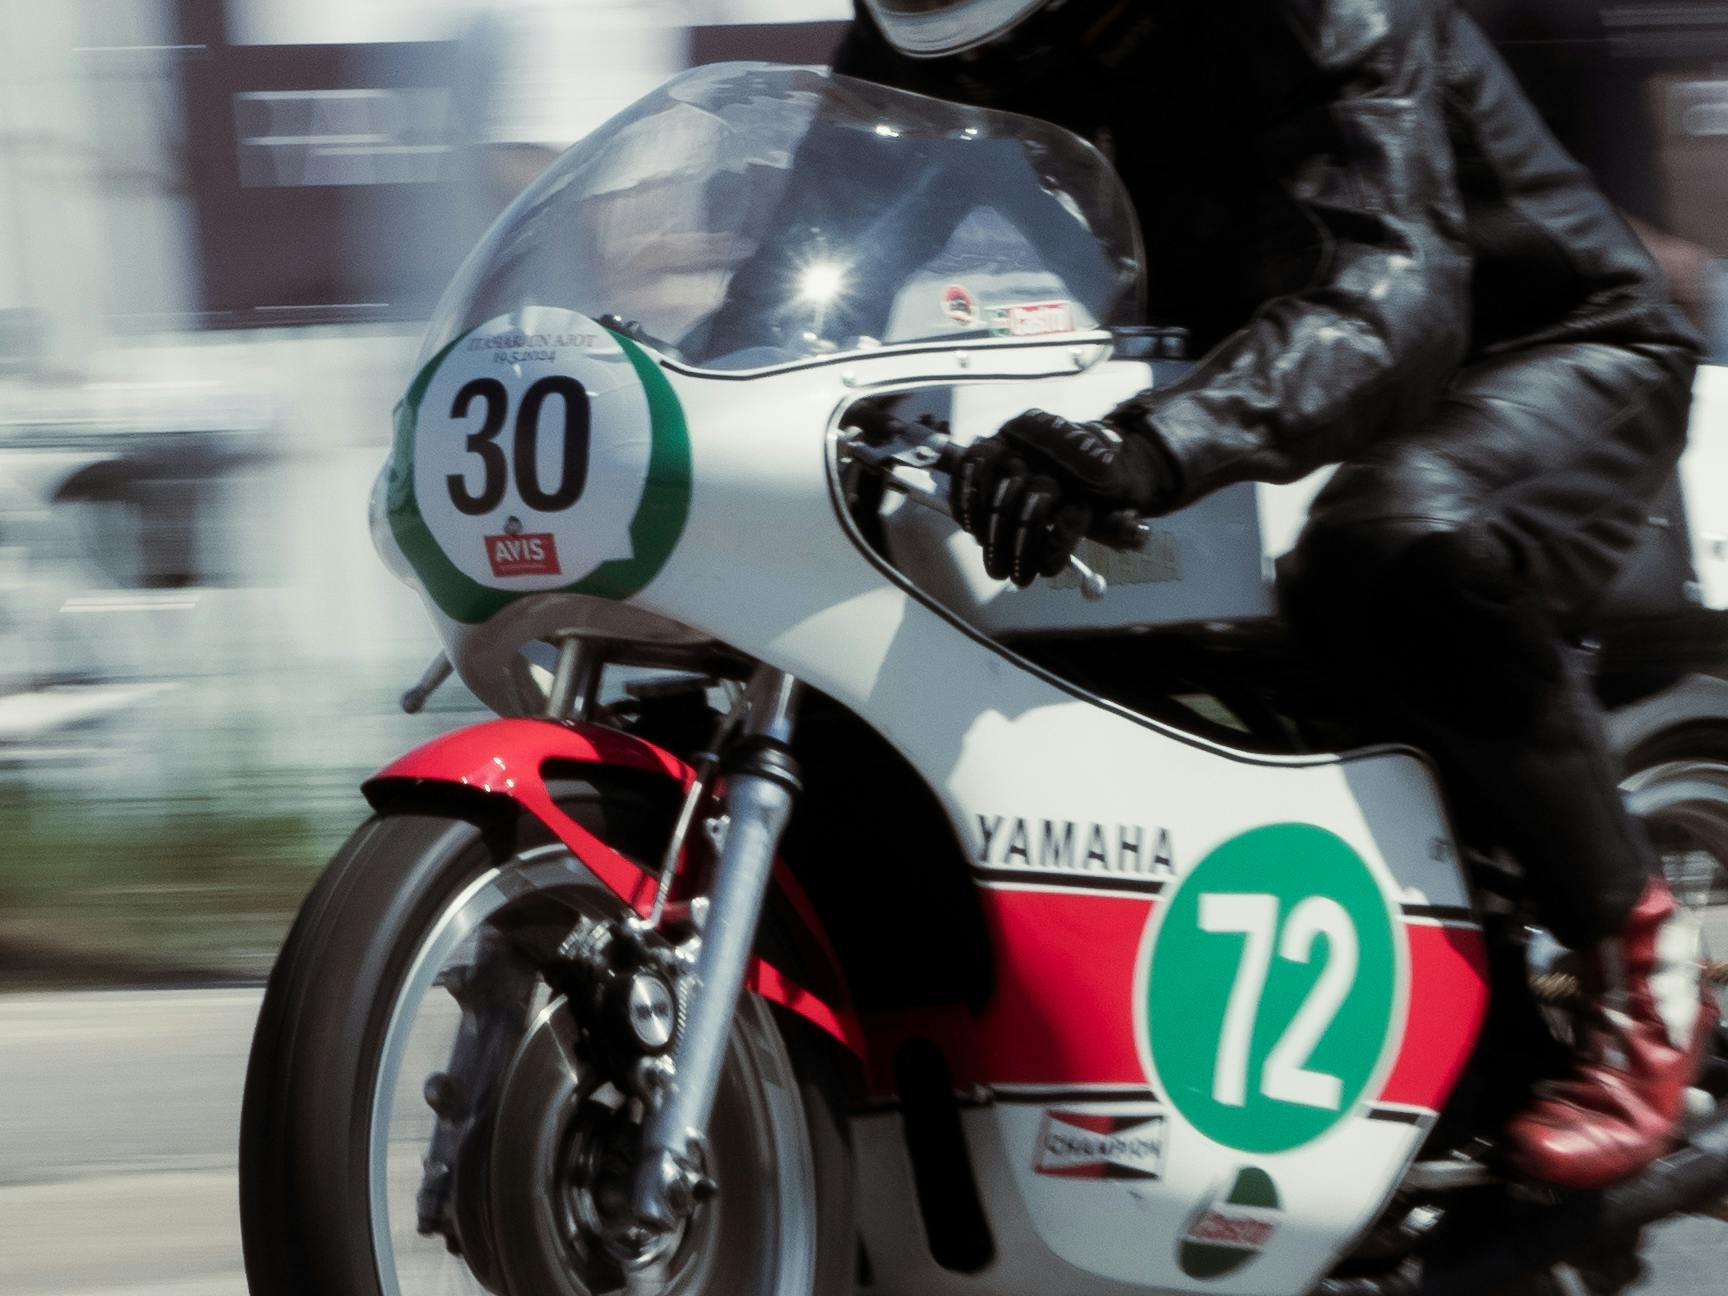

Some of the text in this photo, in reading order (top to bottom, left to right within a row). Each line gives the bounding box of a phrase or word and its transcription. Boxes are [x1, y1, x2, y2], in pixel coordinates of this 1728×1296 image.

[446, 375, 592, 516] 30
[495, 538, 546, 561] AVIS
[975, 812, 1179, 875] YAMAHA
[1197, 890, 1360, 1112] 72
